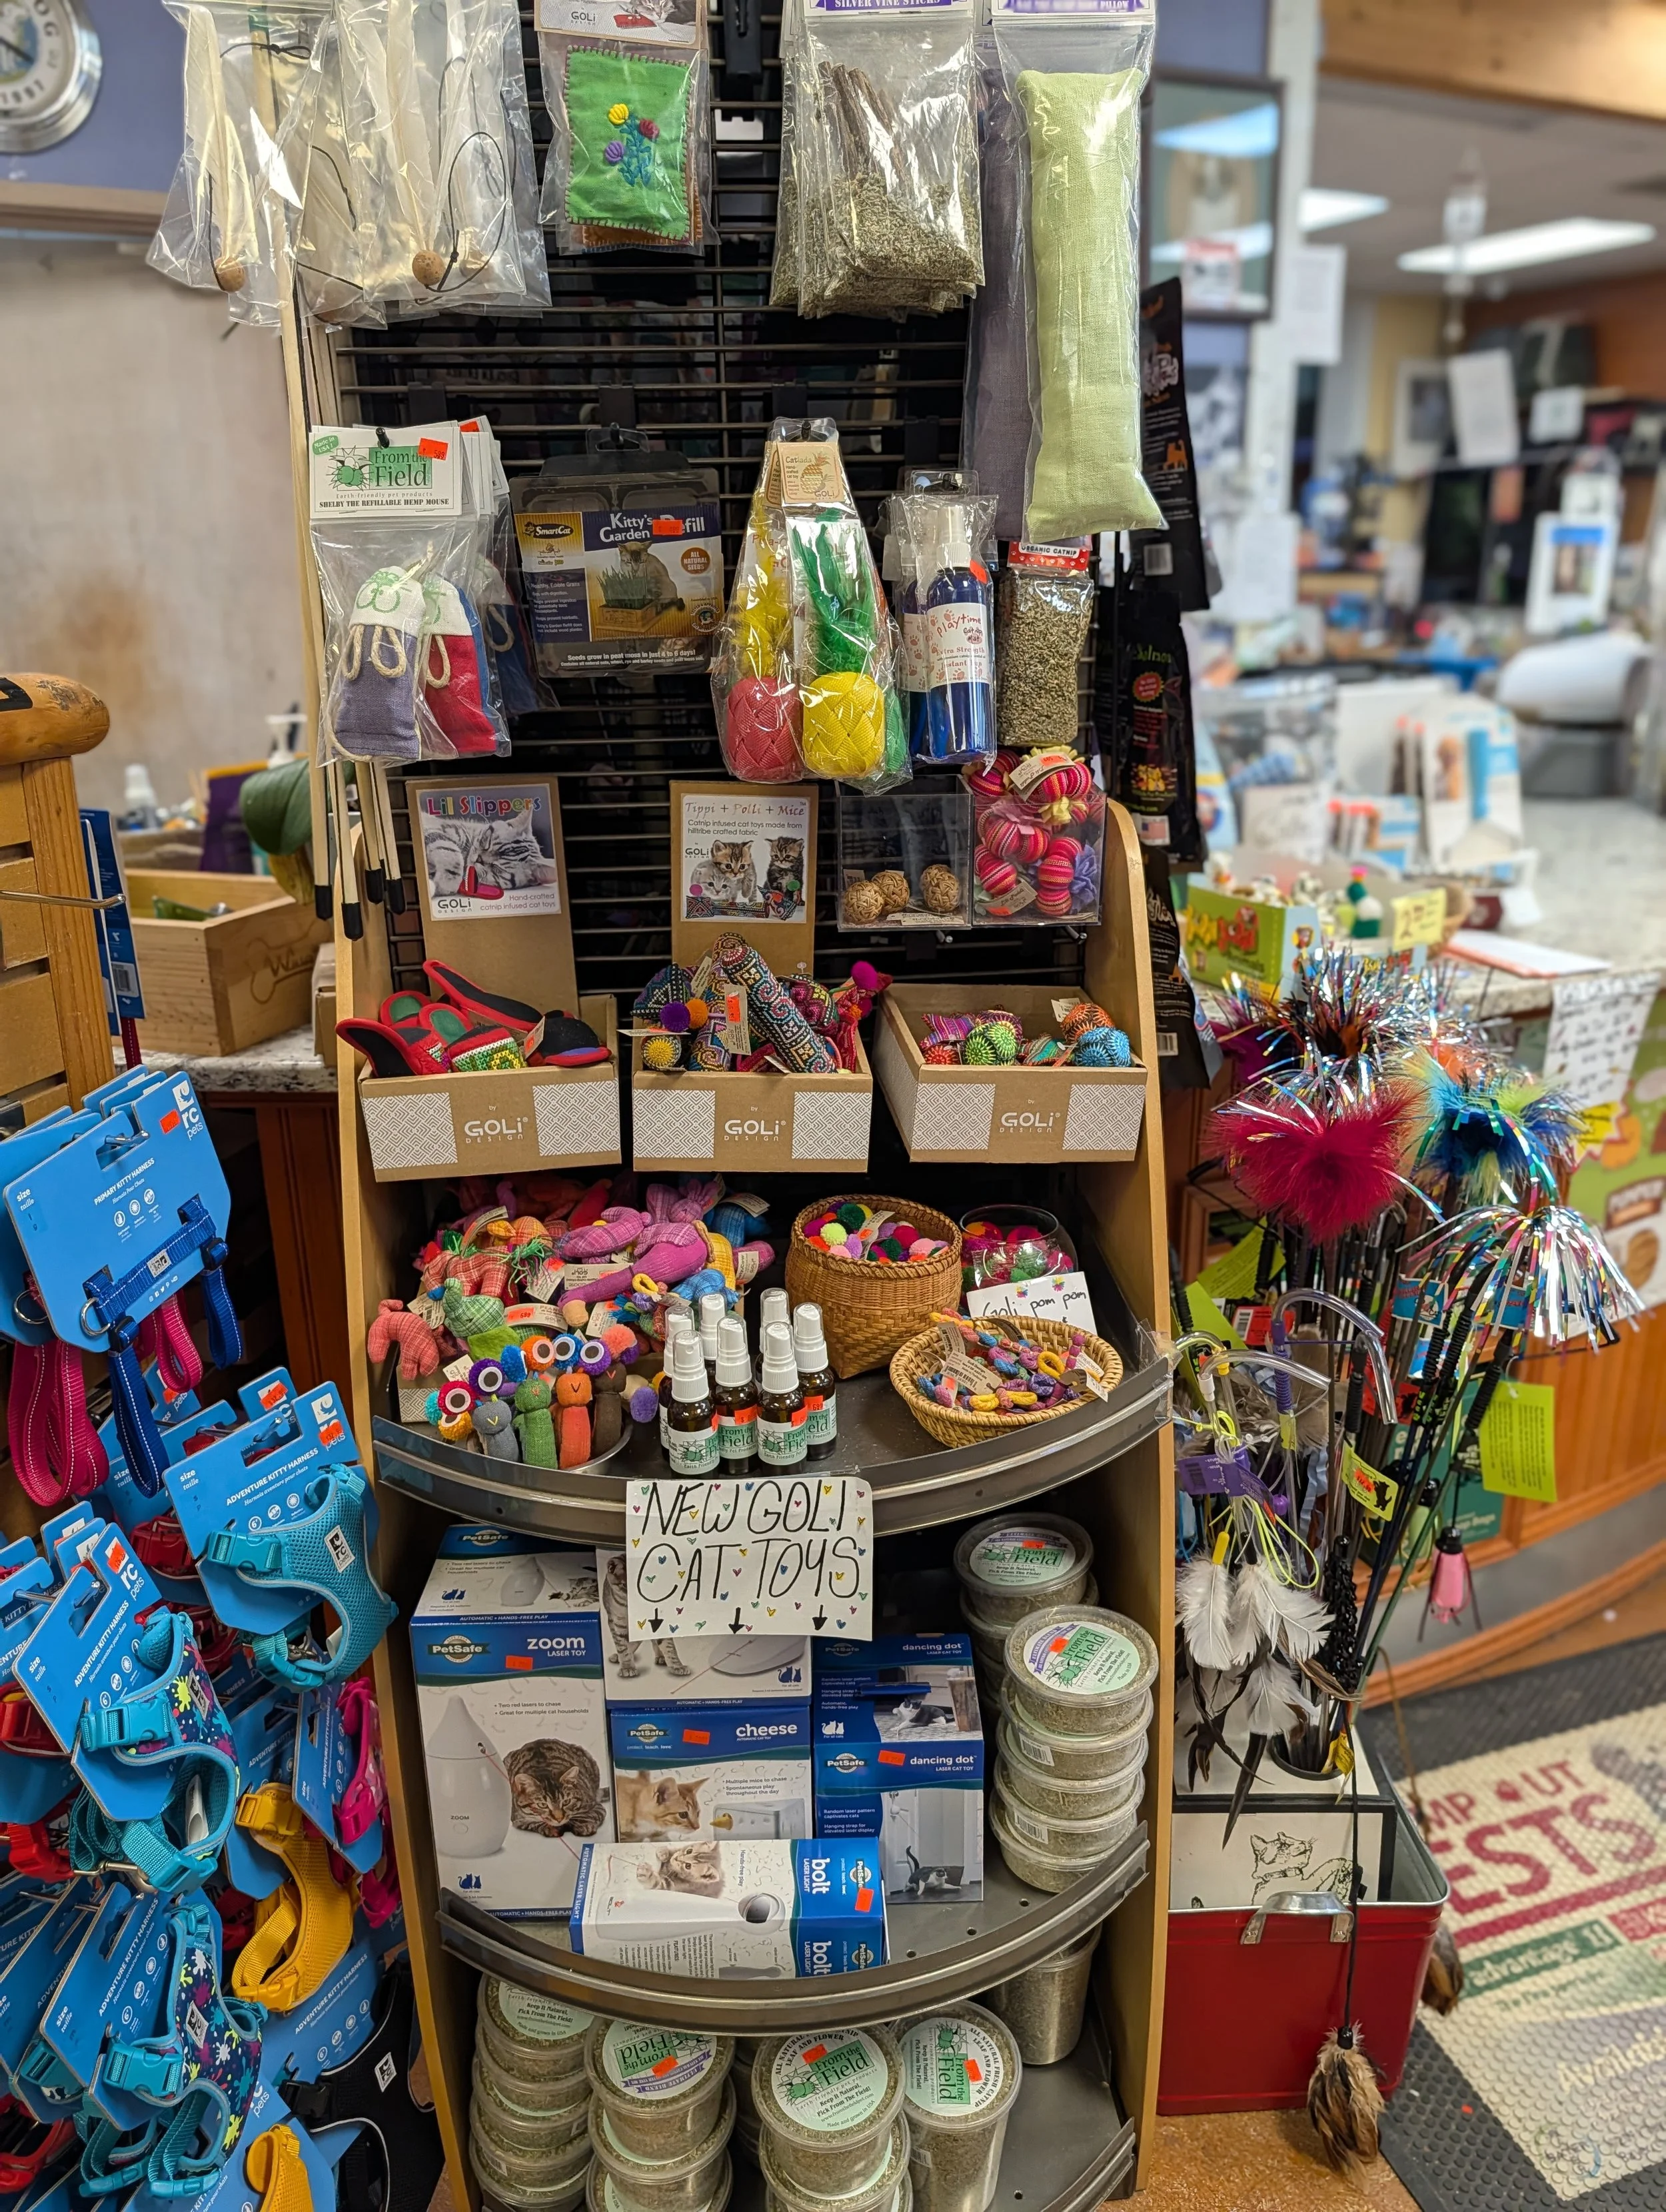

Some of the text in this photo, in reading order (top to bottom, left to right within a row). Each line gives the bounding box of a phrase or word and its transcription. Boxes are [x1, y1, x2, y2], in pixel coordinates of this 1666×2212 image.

[375, 451, 410, 464] From
[375, 464, 428, 487] Field
[600, 527, 650, 542] Garden
[426, 796, 541, 817] Lil Slippers
[685, 802, 715, 820] Tippi
[733, 804, 761, 816] Polli
[778, 805, 805, 816] Mice
[438, 898, 471, 909] GOLi
[182, 1106, 200, 1129] rc
[187, 1121, 203, 1140] pets
[93, 1157, 155, 1205] PRIMARY KITTY HARNESS
[16, 1188, 31, 1203] size
[20, 1198, 35, 1211] taille
[1030, 1297, 1056, 1318] pom
[1063, 1291, 1087, 1310] pom
[721, 1426, 743, 1435] From
[722, 1432, 754, 1447] Field
[179, 1468, 196, 1482] size
[183, 1478, 199, 1491] taille
[227, 1447, 319, 1506] ADVENTURE KITTY HARNESS
[642, 1480, 846, 1536] NEW GOLI
[120, 1561, 139, 1590] rc
[637, 1536, 860, 1602] CAT TOYS
[129, 1576, 146, 1601] pets
[74, 1600, 129, 1688] ADVENTURE KITTY HARNESS
[432, 1645, 483, 1654] PetSafe
[526, 1637, 585, 1650] zoom
[902, 1643, 942, 1653] dancing
[1064, 1630, 1091, 1657] From the
[1074, 1632, 1108, 1662] Field
[29, 1656, 41, 1675] size
[736, 1724, 798, 1738] cheese
[910, 1756, 974, 1766] dancing dot
[812, 1858, 830, 1894] bolt
[97, 1896, 159, 2017] ADVENTURE KITTY HARNESS
[294, 1952, 369, 2035] ADVENTURE KITTY HARNESS
[970, 2027, 982, 2037] ALL
[619, 2034, 668, 2065] Field
[780, 2035, 805, 2060] NATURAL
[785, 2033, 844, 2067] LEAF AND FLOWER
[815, 2046, 860, 2071] From the
[982, 2035, 1000, 2065] NATURAL
[624, 2061, 638, 2070] the
[821, 2052, 870, 2086] Field
[956, 2057, 966, 2089] From
[938, 2057, 958, 2101] Field
[253, 2089, 271, 2119] pets
[817, 2085, 872, 2117] Pick From The Field!
[820, 2096, 834, 2107] Keep
[840, 2083, 862, 2097] Natural,
[974, 2088, 994, 2107] CATNIP
